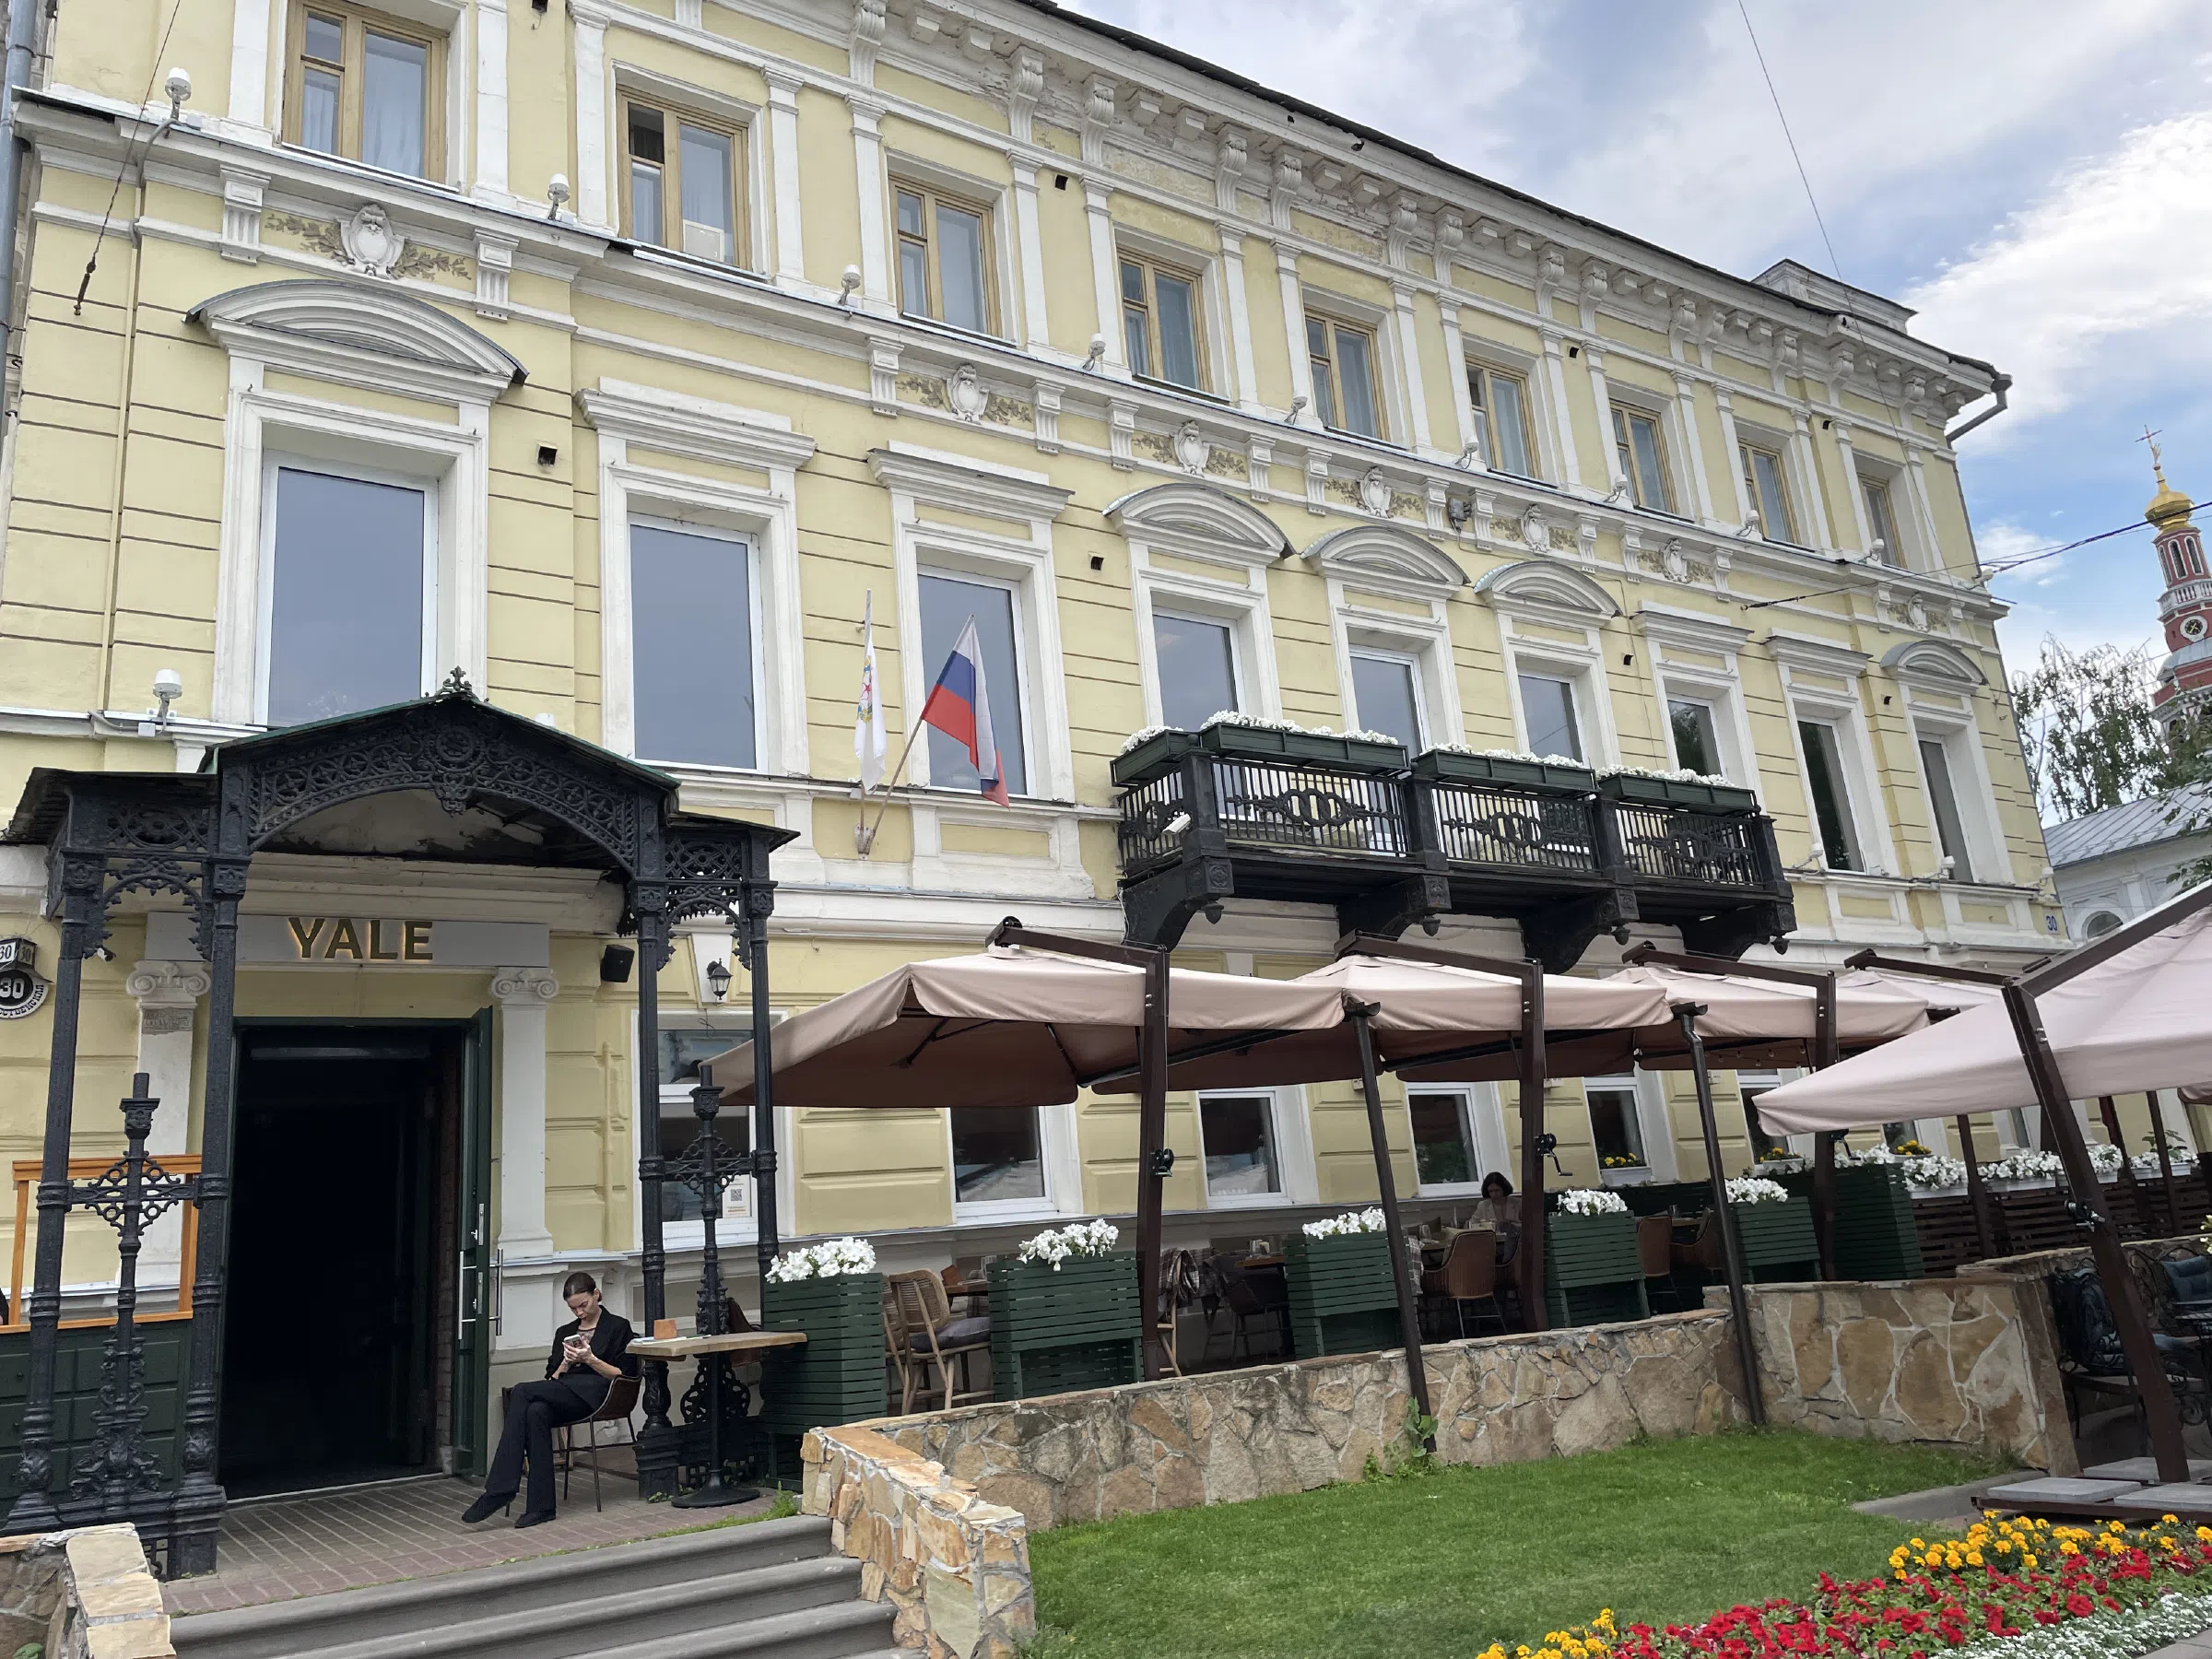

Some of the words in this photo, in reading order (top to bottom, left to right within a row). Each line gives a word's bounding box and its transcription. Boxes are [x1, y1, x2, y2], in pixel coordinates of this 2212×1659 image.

[2046, 915, 2057, 931] 30
[288, 917, 433, 959] YALE
[21, 946, 31, 962] 30
[0, 977, 25, 999] 30
